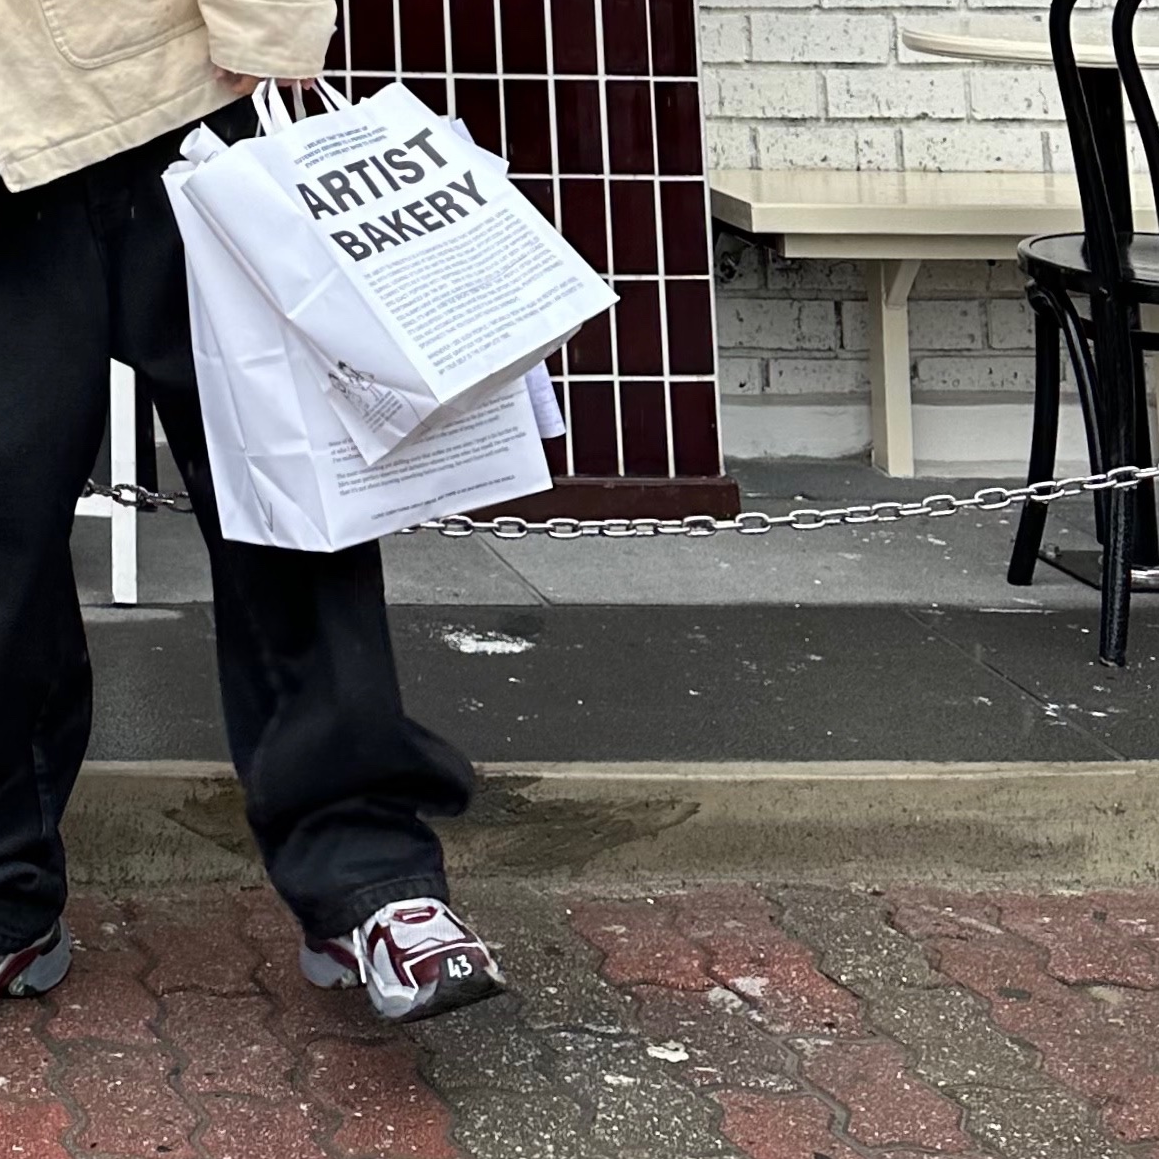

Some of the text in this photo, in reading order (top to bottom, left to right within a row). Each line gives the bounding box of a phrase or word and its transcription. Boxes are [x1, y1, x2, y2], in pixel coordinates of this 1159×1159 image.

[296, 127, 448, 220] ARTIST
[330, 170, 488, 262] BAKERY
[447, 954, 472, 979] 43
